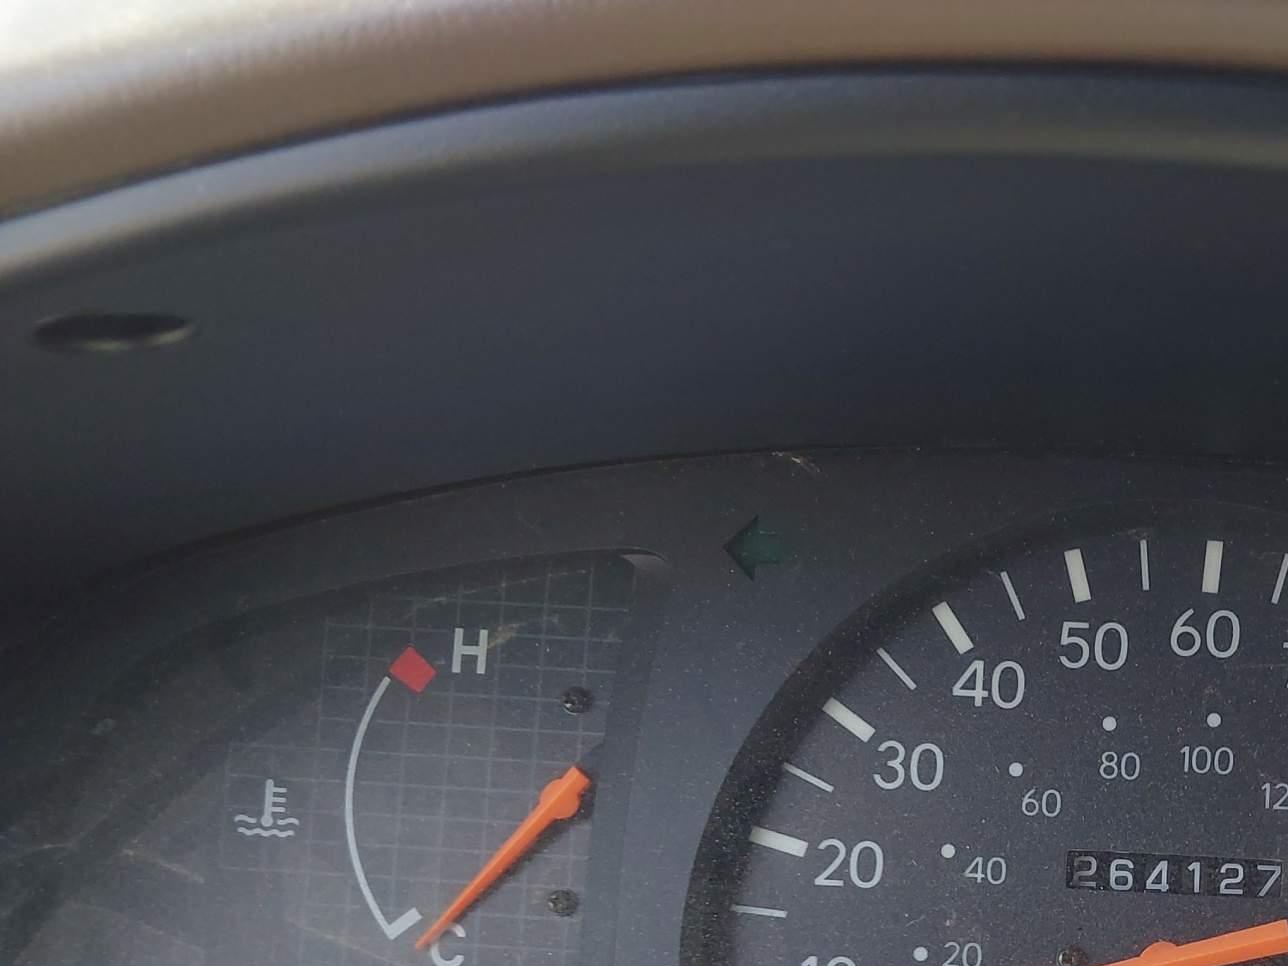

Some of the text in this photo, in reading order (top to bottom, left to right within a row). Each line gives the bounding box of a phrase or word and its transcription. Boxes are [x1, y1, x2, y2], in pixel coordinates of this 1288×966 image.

[452, 628, 488, 674] H
[1060, 622, 1128, 670] 50
[1171, 609, 1240, 658] 60
[953, 660, 1024, 708] 40
[874, 741, 943, 790] 30
[1100, 752, 1140, 780] 80
[1180, 746, 1233, 774] 100
[1022, 789, 1061, 817] 60
[815, 839, 883, 888] 20
[964, 857, 1006, 884] 40
[1073, 855, 1282, 897] 264127
